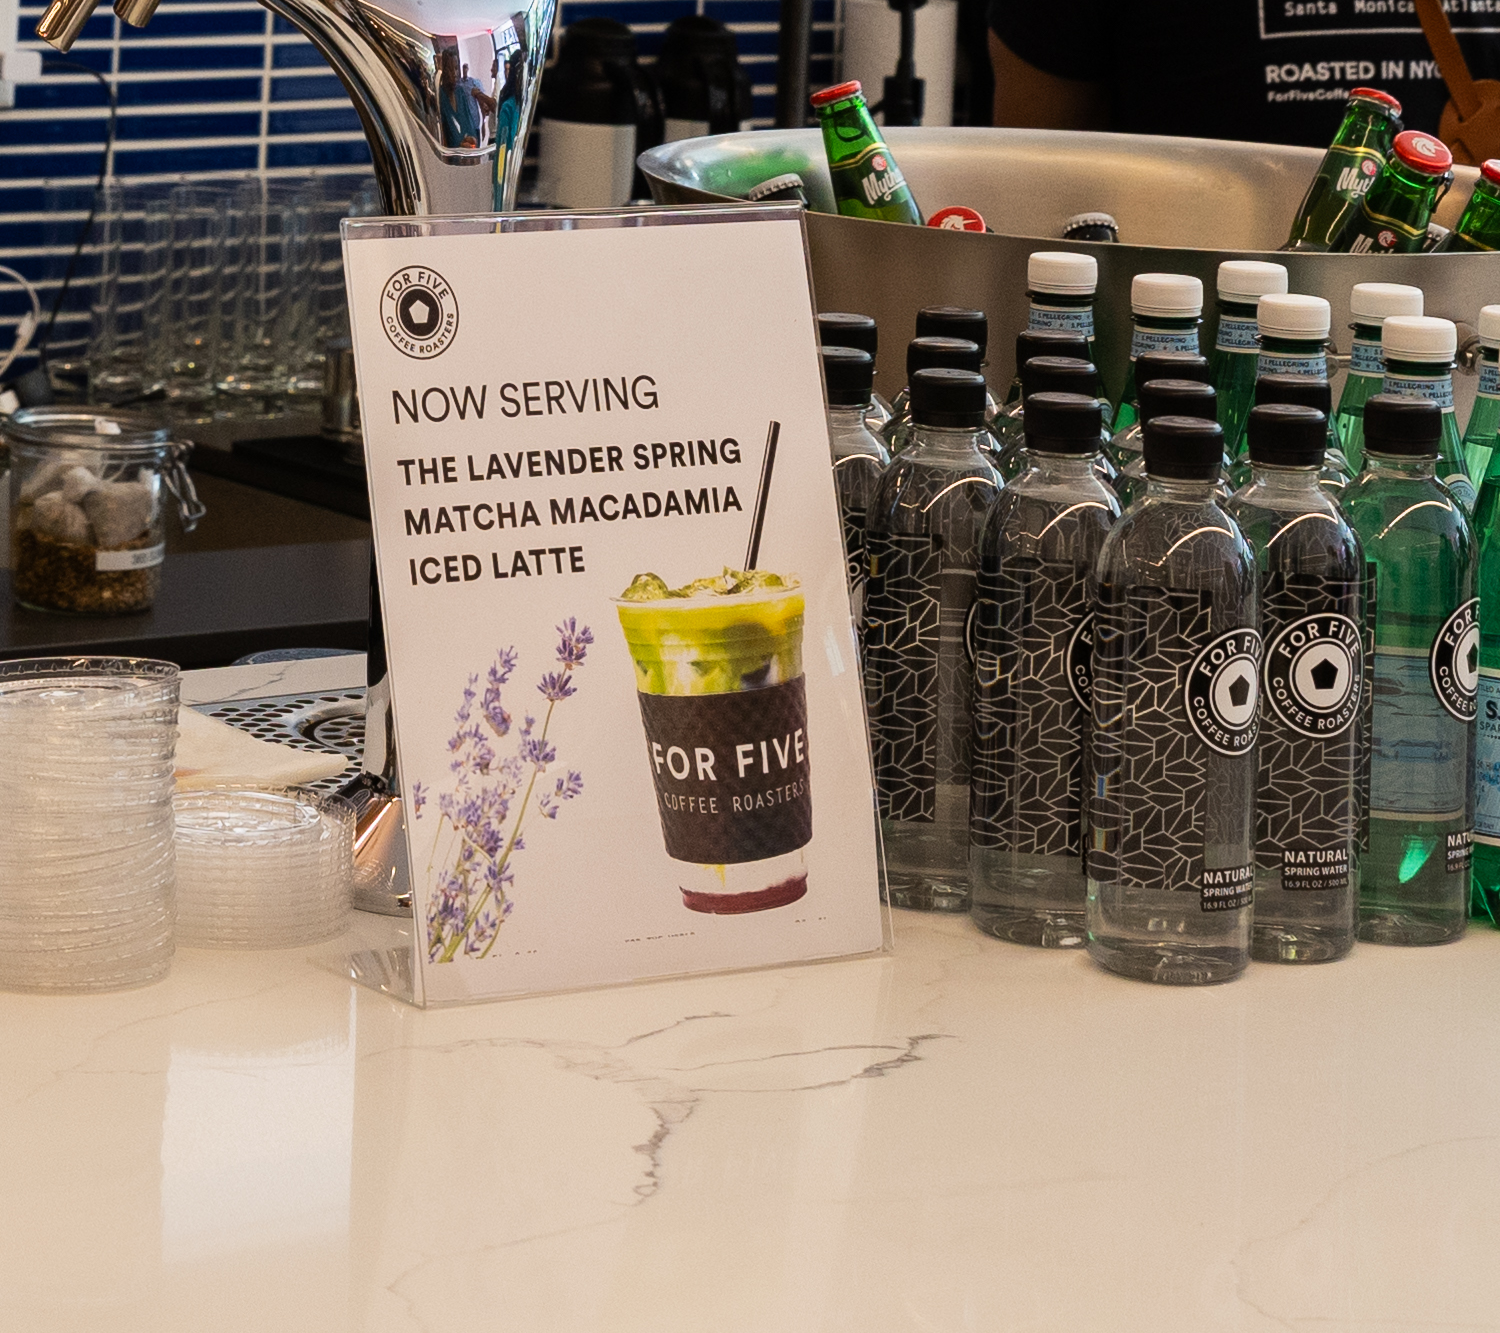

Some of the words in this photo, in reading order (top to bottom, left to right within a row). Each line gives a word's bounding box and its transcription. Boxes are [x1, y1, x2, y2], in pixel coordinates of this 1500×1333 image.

[1265, 60, 1375, 84] ROASTED
[1381, 60, 1405, 81] IN
[386, 272, 412, 301] FOR
[418, 271, 449, 300] FIVE
[386, 316, 416, 352] COFFEE
[419, 313, 454, 354] ROASTERS
[391, 384, 487, 425] NOW
[499, 374, 660, 419] SERVING
[397, 456, 459, 486] THE
[466, 445, 625, 482] LAVENDER
[632, 437, 742, 470] SPRING
[404, 499, 541, 536] MATCHA
[549, 486, 744, 526] MACADAMIA
[409, 554, 483, 586] ICED
[491, 545, 586, 580] LATTE
[1278, 622, 1321, 659] FOR
[1328, 620, 1361, 658] FIVE
[1272, 677, 1314, 728] COFFEE
[1317, 674, 1361, 730] ROASTERS
[651, 741, 718, 782] FOR
[735, 728, 805, 778] FIVE
[664, 791, 719, 814] COFFEE
[732, 779, 805, 813] ROASTERS
[1284, 849, 1349, 864] NATURAL
[1284, 865, 1314, 877] SPRING
[1314, 864, 1348, 876] WATER
